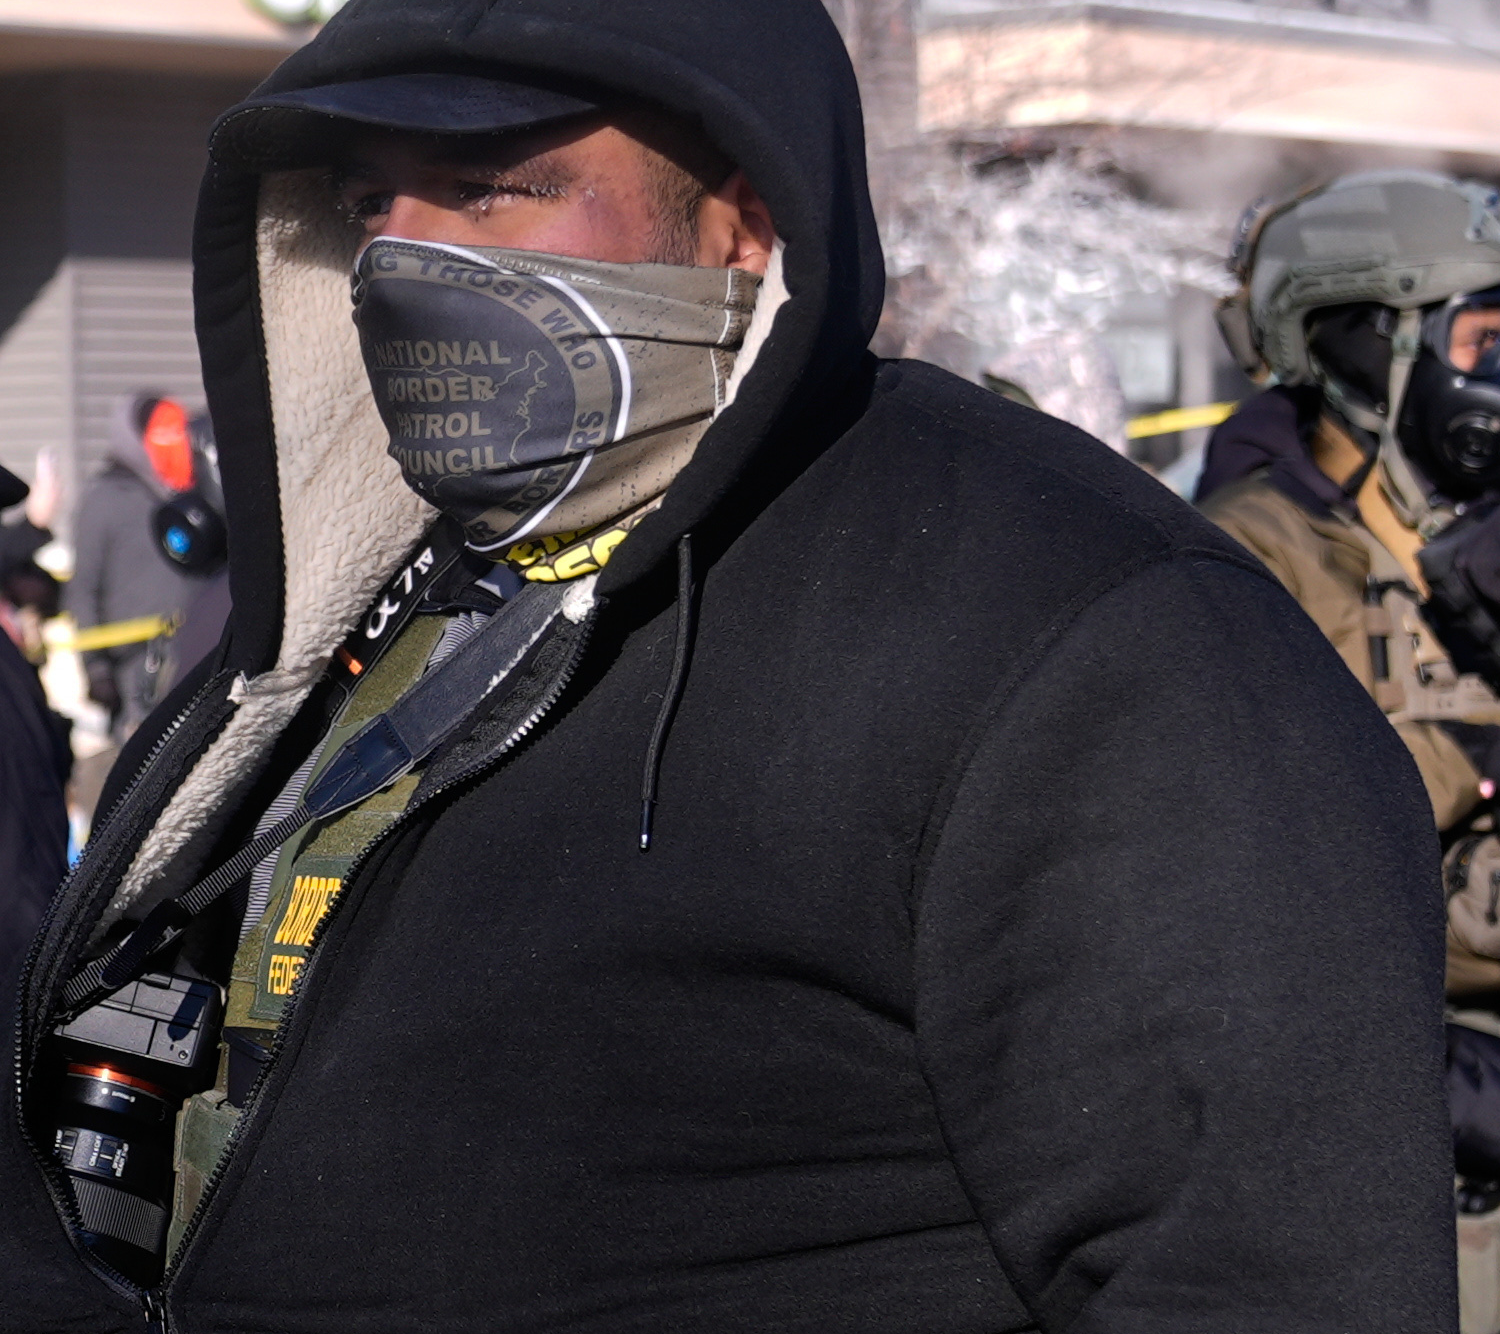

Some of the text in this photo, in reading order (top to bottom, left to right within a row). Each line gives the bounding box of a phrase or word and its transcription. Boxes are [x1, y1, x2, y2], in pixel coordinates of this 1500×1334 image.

[417, 256, 544, 310] THOSE
[540, 307, 597, 370] WHO
[373, 340, 512, 367] NATIONAL
[387, 375, 496, 403] BORDER
[273, 874, 341, 947] BORDE
[267, 954, 305, 995] FEDE
